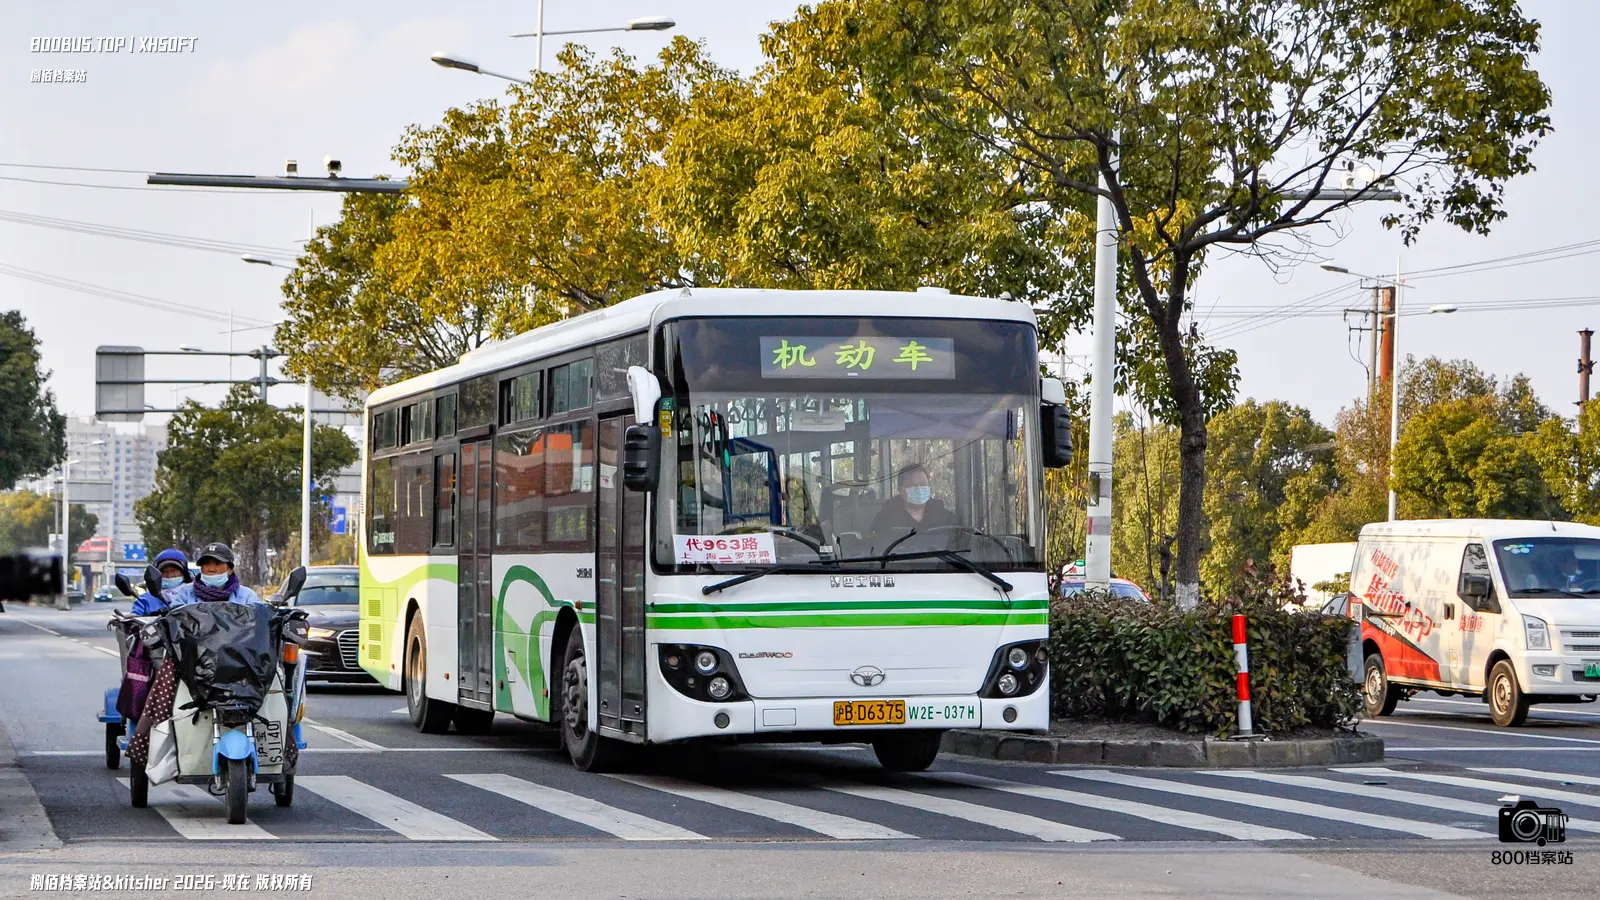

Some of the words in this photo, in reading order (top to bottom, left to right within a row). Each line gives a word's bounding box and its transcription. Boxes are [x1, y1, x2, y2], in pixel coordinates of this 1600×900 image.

[773, 339, 933, 371] 机动车
[686, 537, 758, 551] 代963路
[738, 651, 794, 660] DAEWOO
[908, 705, 976, 721] W2E-037H
